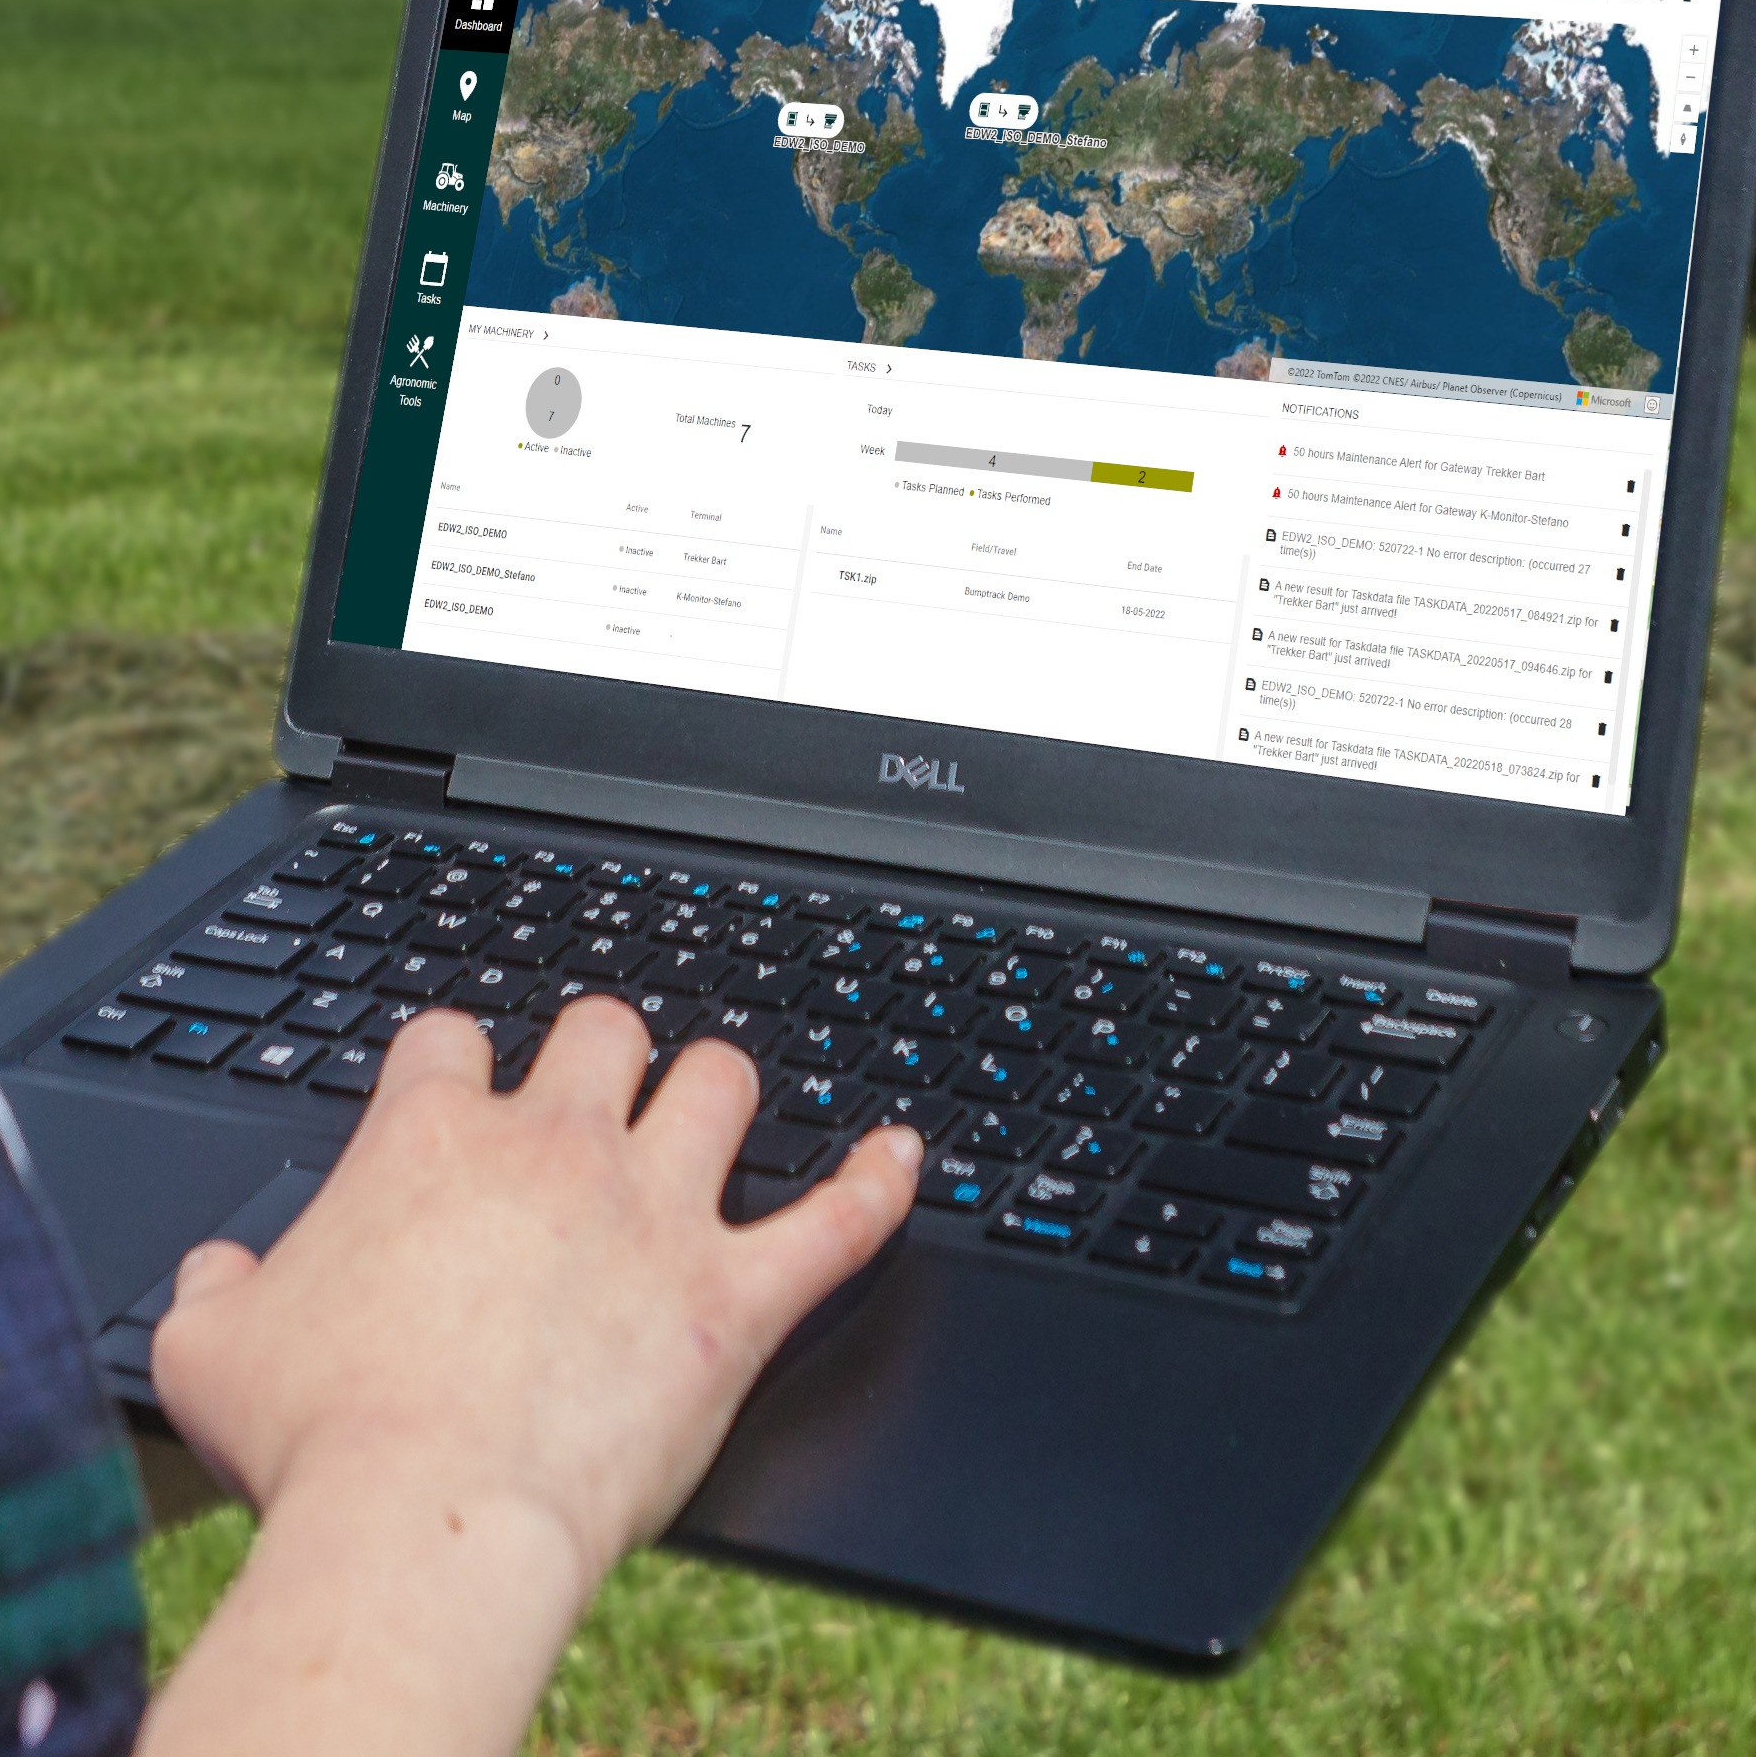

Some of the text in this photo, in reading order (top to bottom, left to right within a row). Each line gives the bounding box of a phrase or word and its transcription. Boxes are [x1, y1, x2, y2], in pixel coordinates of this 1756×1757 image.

[454, 18, 503, 31] Dashboard
[452, 109, 472, 123] Map
[773, 136, 866, 154] EDW2_ISO_DEMO
[965, 127, 1108, 149] EDW2_ISO_DEMO_Stefano
[422, 199, 469, 215] Machinery
[417, 292, 441, 304] Tasks
[468, 324, 534, 338] MY MACHINERY
[847, 360, 876, 373] TASKS
[389, 374, 437, 390] Agronomic
[554, 374, 561, 386] 0
[1287, 367, 1562, 403] ©2022 TomTom ©2022 CNES/ Airbus/ Planet Observer (Copernicus)
[399, 394, 422, 407] Tools
[1590, 395, 1631, 408] Microsoft
[548, 410, 555, 421] 7
[867, 403, 893, 417] Today
[1282, 402, 1359, 420] NOTIFICATIONS
[675, 412, 736, 428] Total Machines
[740, 424, 751, 443] 7
[523, 441, 549, 453] Active
[560, 445, 592, 457] Inactive
[860, 444, 885, 456] Week
[988, 454, 996, 467] 4
[1293, 446, 1545, 482] 50 hours Maintenance Alert for Gateway Trekker Bart
[1137, 470, 1146, 484] 2
[440, 481, 461, 492] Name
[902, 480, 965, 496] Tasks Planned
[977, 488, 1051, 506] Tasks Performed
[625, 503, 649, 513] Active
[690, 510, 722, 522] Terminal
[1287, 488, 1569, 528] 50 hours Maintenance Alert for Gateway K-Monitor-Stefano
[437, 522, 507, 539] EDW2_ISO_DEMO
[820, 525, 843, 535] Name
[625, 545, 654, 556] Inactive
[971, 542, 1017, 556] Field/Travel
[1280, 545, 1316, 561] time(s))
[1281, 530, 1591, 574] EDW2_ISO_DEMO: 520722-1 No error description: (occurred 27
[683, 552, 727, 565] Trekker Bart
[431, 560, 535, 582] EDW2_ISO_DEMO_Stefano
[1127, 561, 1163, 573] End Date
[839, 570, 877, 586] TSK1.zip
[619, 585, 647, 596] Inactive
[964, 586, 1030, 602] Bumptrack Demo
[424, 598, 494, 616] EDW2_ISO_DEMO
[676, 591, 742, 608] K-Monitor-Stefano
[1273, 594, 1397, 618] "Trekker Bart" just arrived!
[1274, 580, 1599, 627] A new result for Taskdata file TASKDATA_20220517_084921.zip for
[1121, 605, 1165, 619] 18-05-2022
[612, 623, 641, 635] Inactive
[1266, 644, 1391, 669] "Trekker Bart" just arrived!
[1267, 630, 1592, 679] A new result for Taskdata file TASKDATA_20220517_094646.zip for
[1259, 694, 1296, 710] time(s))
[1261, 680, 1572, 729] EDW2_ISO_DEMO: 520722-1 No error description: (occurred 28
[1253, 744, 1377, 770] "Trekker Bart" just arrived!
[1254, 730, 1580, 783] A new result for Taskdata file TASKDATA_20220518_073824.zip for
[878, 752, 965, 794] DELL
